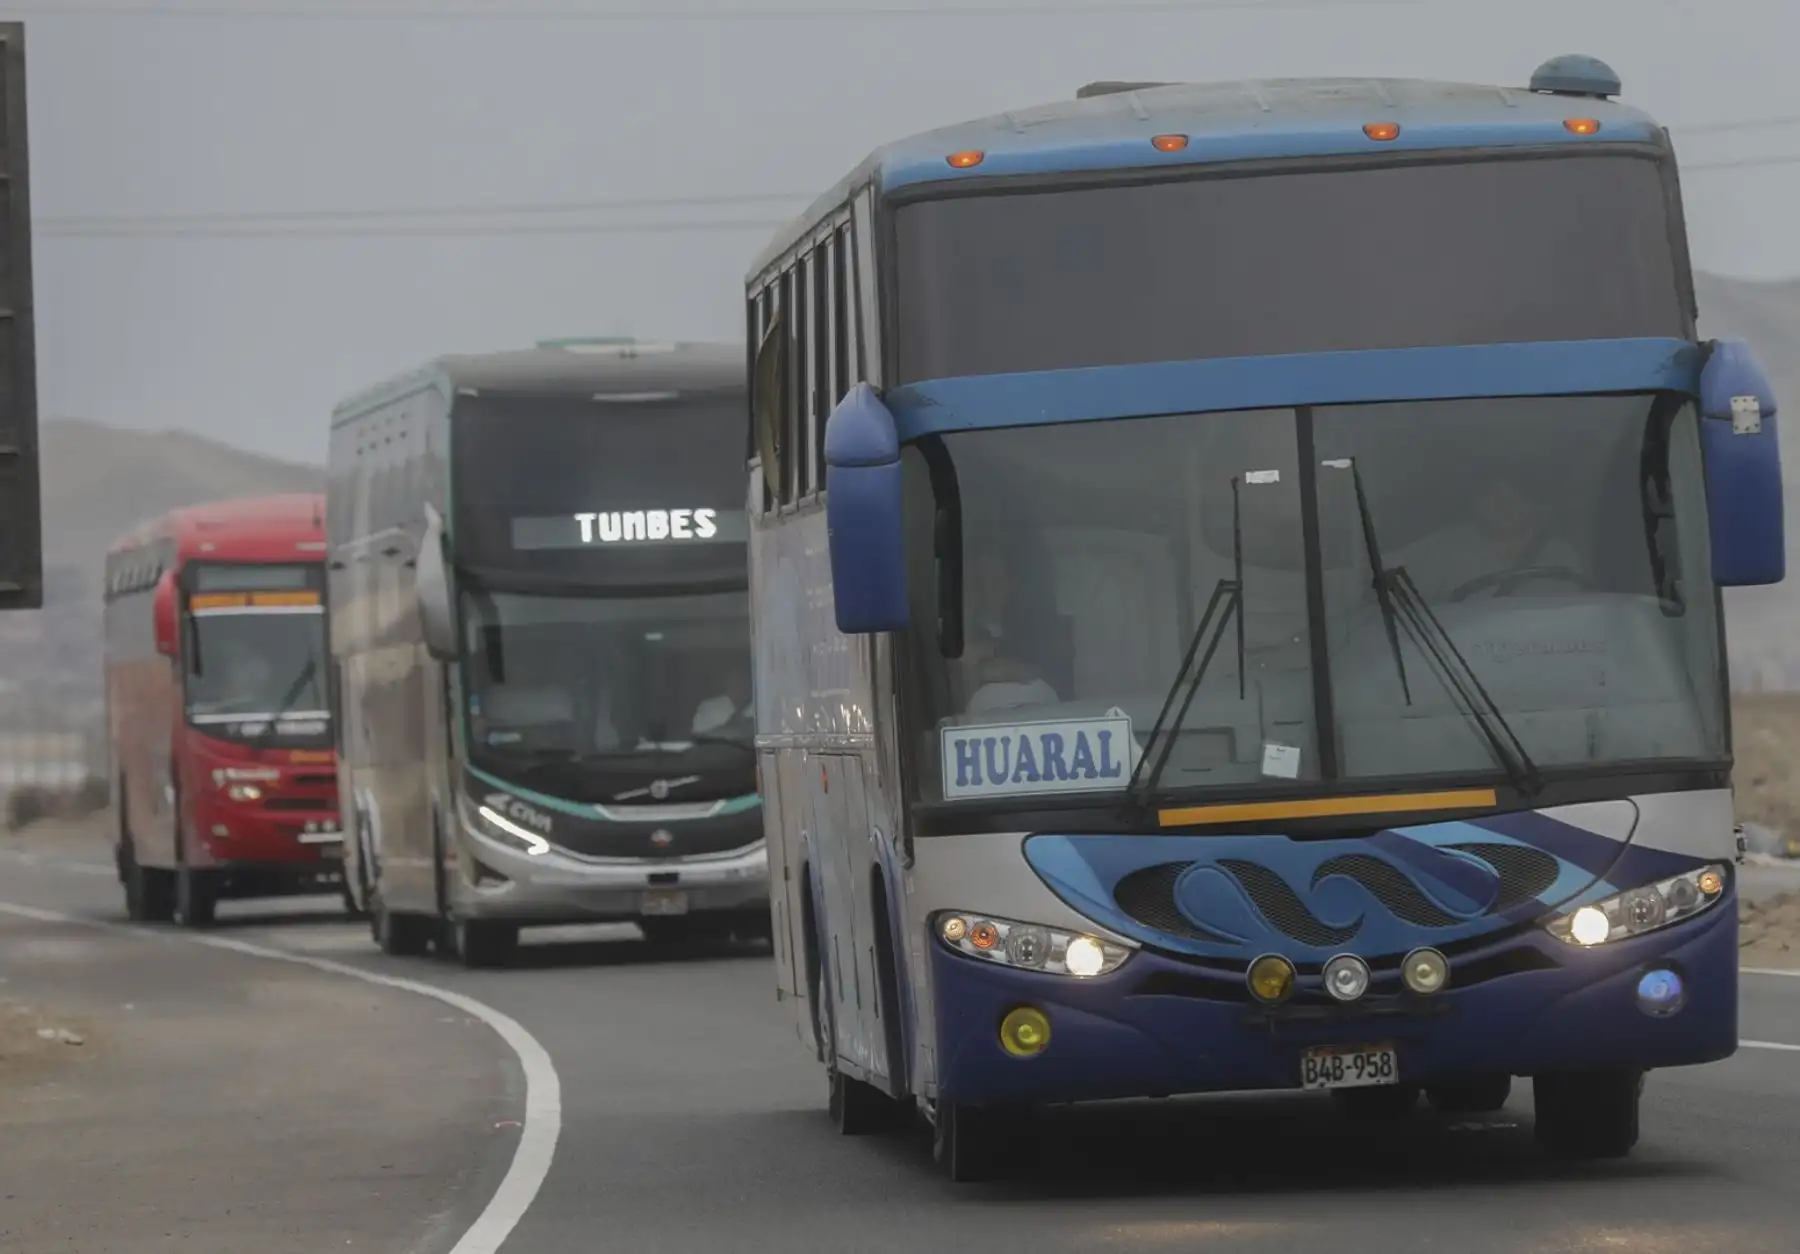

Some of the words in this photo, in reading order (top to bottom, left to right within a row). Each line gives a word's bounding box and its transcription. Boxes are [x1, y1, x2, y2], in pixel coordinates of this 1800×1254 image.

[574, 509, 717, 542] TUMBES
[955, 731, 1122, 786] HUARAL
[1306, 1053, 1392, 1084] B4B-958
